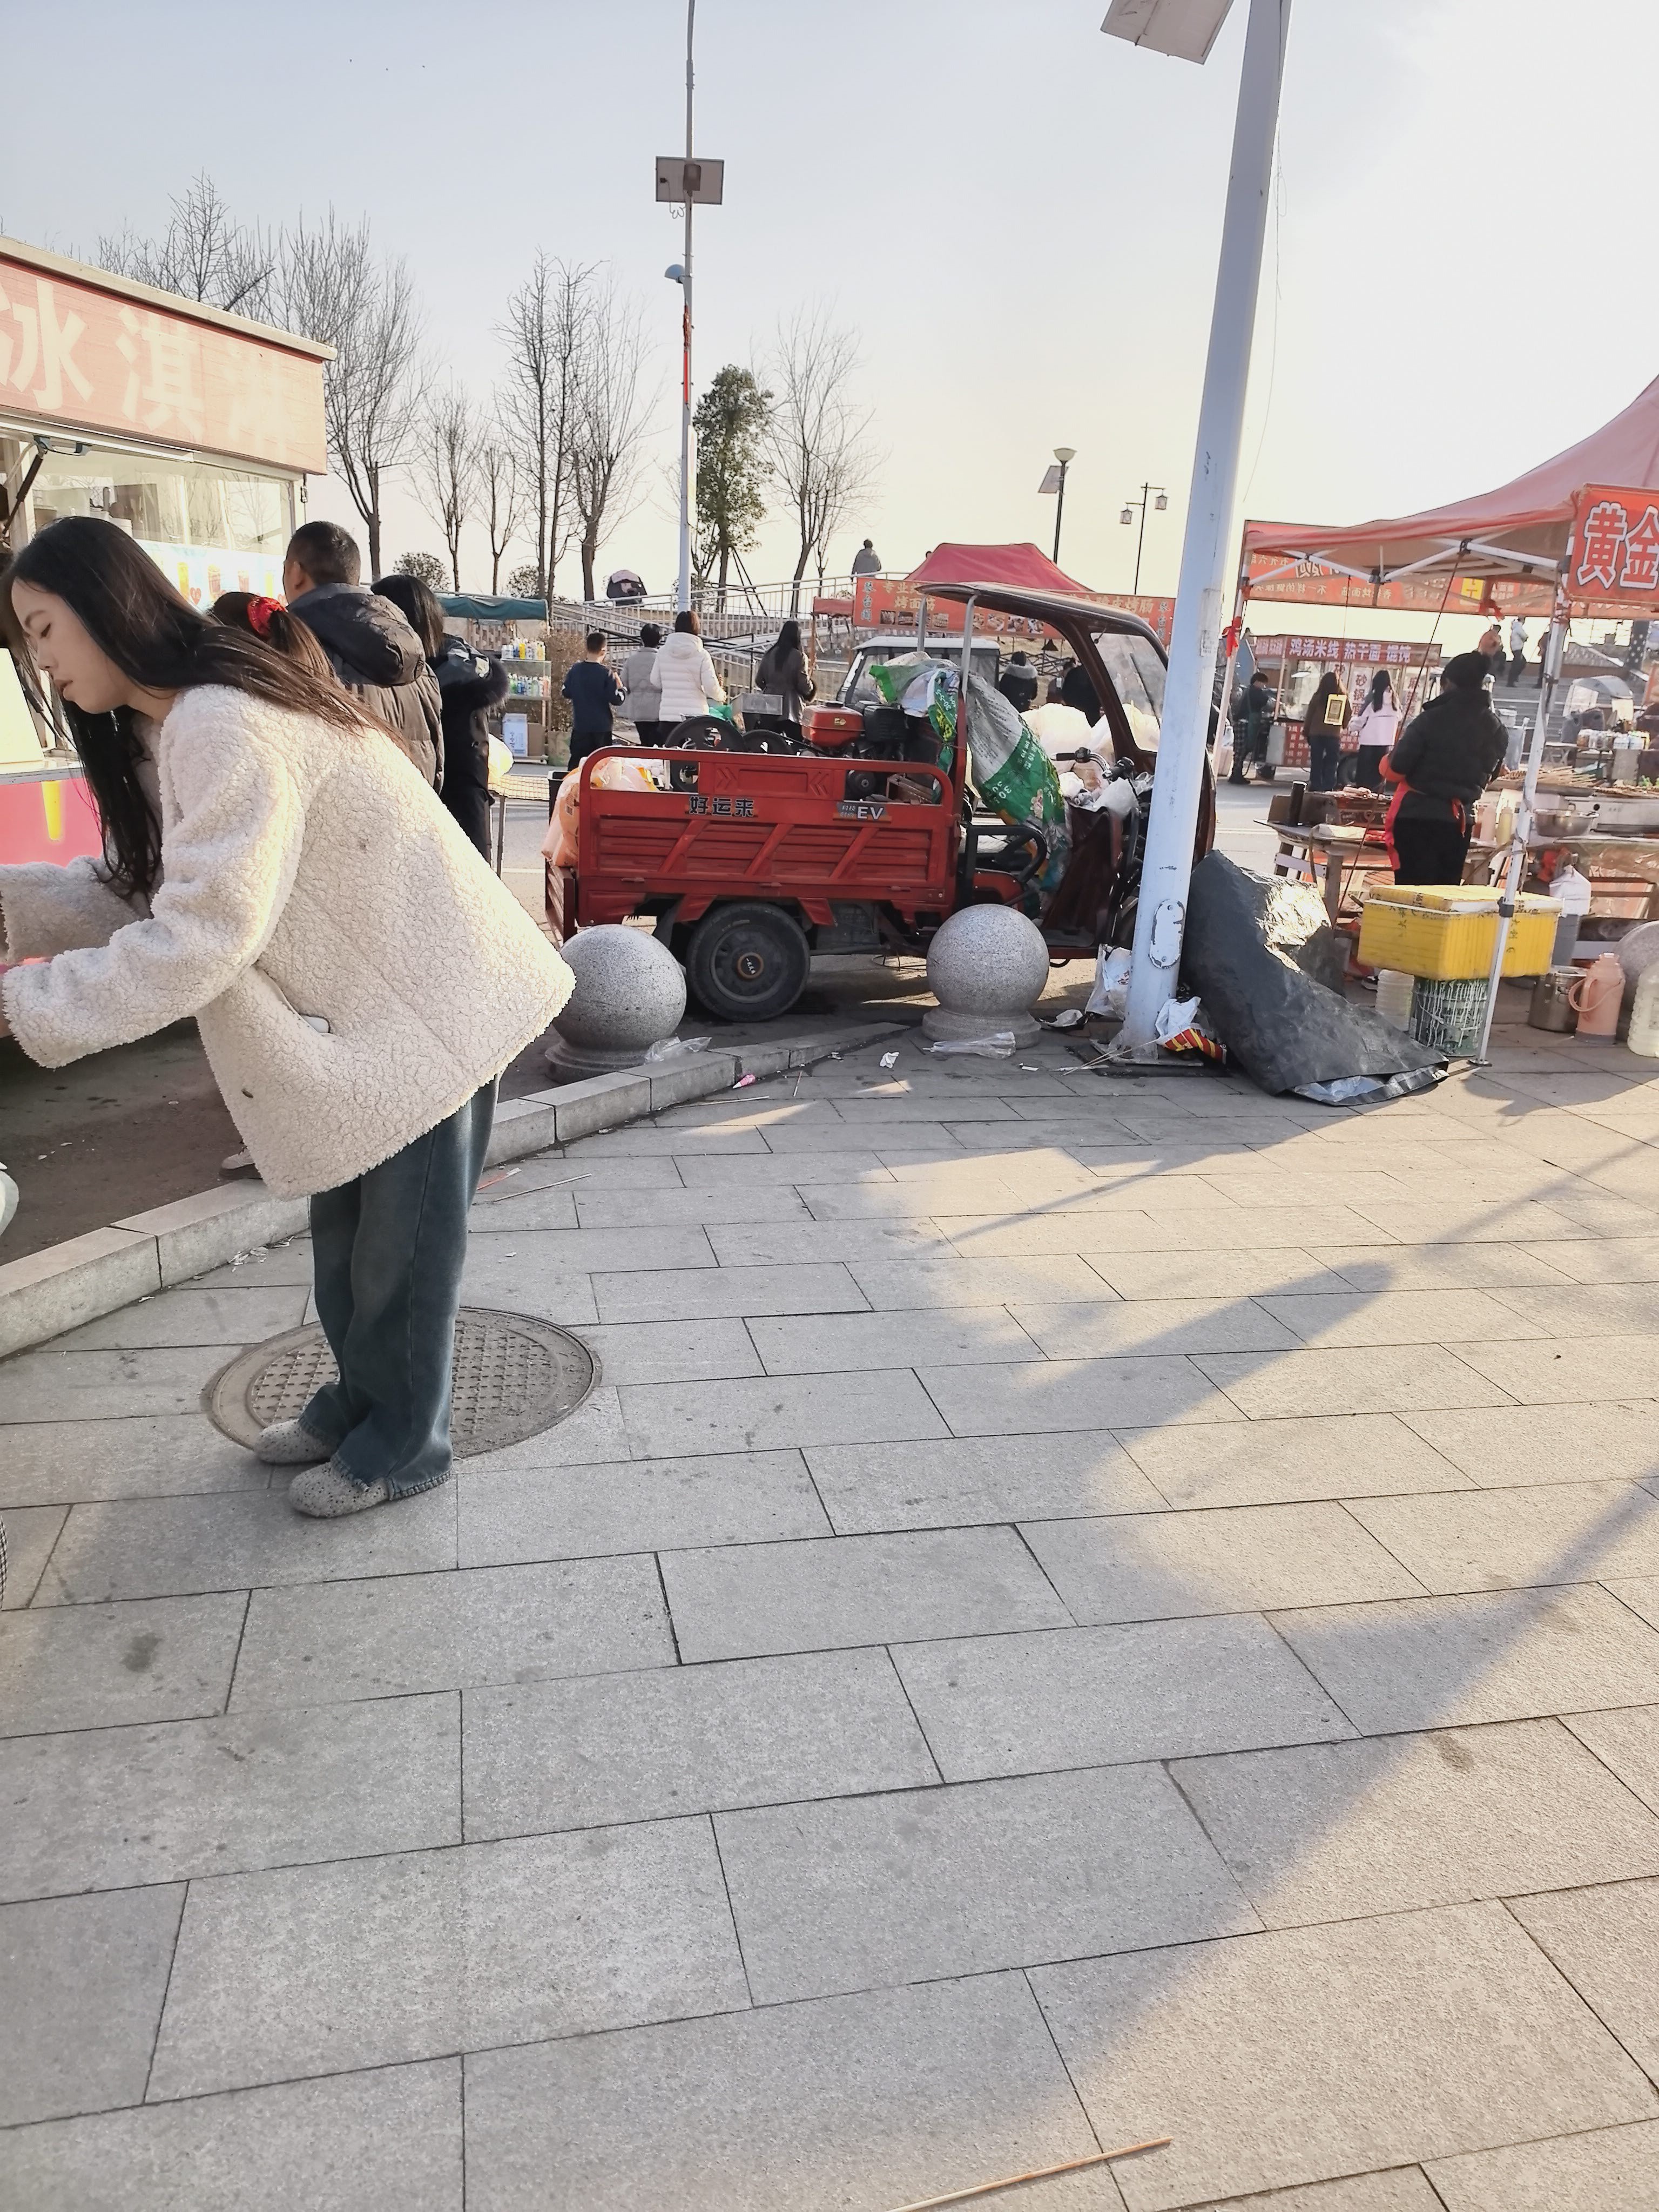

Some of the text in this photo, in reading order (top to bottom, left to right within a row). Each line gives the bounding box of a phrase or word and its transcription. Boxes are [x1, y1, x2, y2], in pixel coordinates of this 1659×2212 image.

[1577, 501, 1659, 590] 黄金
[1289, 638, 1340, 659] 鸡汤米线
[1344, 641, 1382, 662] 热干面
[690, 796, 755, 817] 好运来
[857, 806, 884, 820] EV
